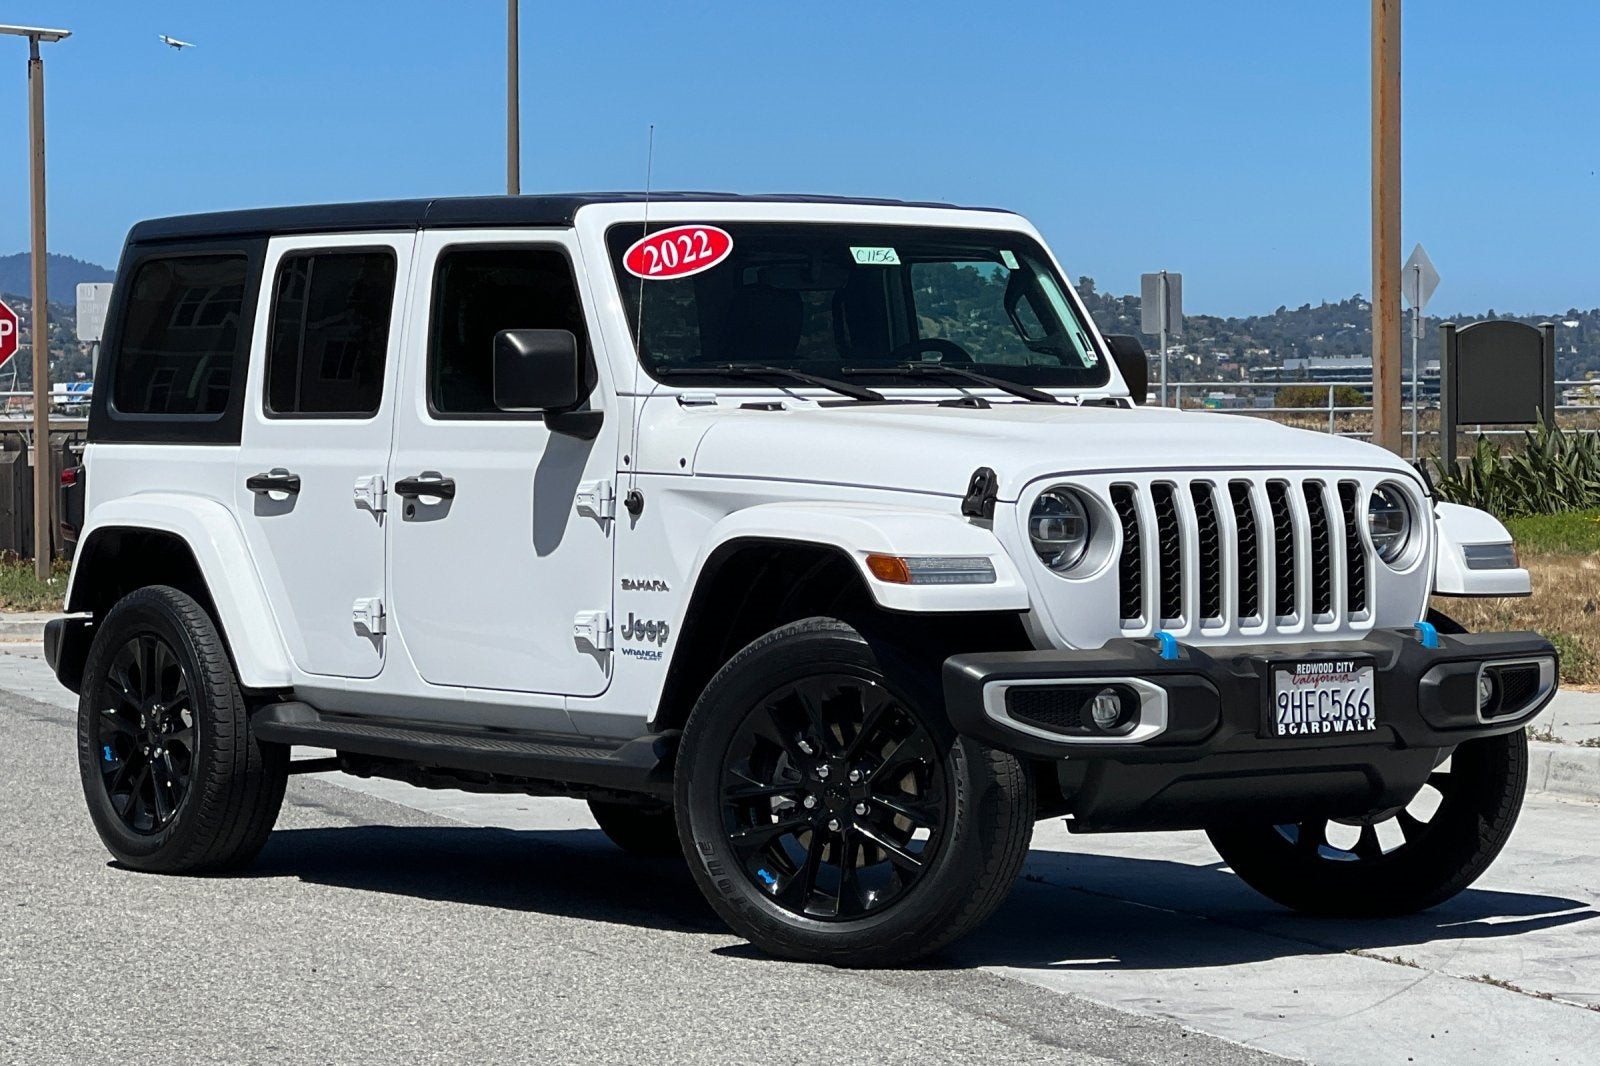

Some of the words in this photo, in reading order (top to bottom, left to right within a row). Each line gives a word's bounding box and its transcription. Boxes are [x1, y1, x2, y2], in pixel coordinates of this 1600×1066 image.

[643, 230, 712, 274] 2022
[620, 612, 670, 647] Jeep
[1292, 673, 1350, 687] California
[1296, 662, 1334, 675] REDWOOD
[1336, 661, 1355, 673] CITY
[1277, 687, 1371, 724] 9HFC566
[1277, 717, 1377, 736] BOARDWALK
